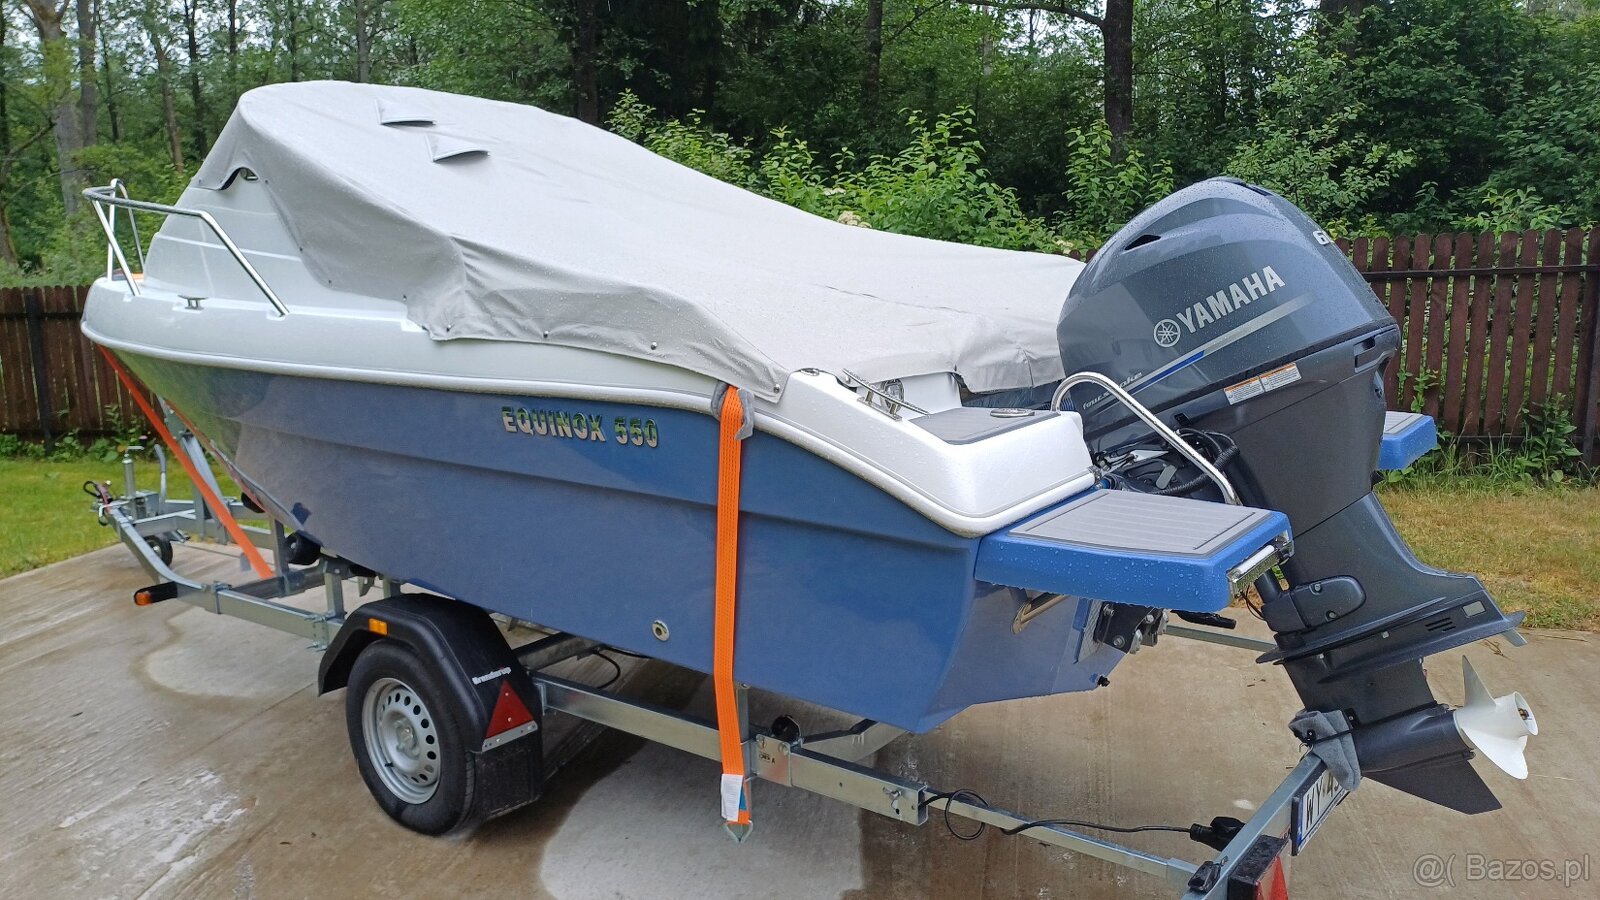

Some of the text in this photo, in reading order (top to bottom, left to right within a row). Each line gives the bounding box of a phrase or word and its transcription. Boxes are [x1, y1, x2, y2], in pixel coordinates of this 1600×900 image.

[1176, 265, 1286, 334] YAMAHA
[501, 406, 658, 448] EQUINOX 550
